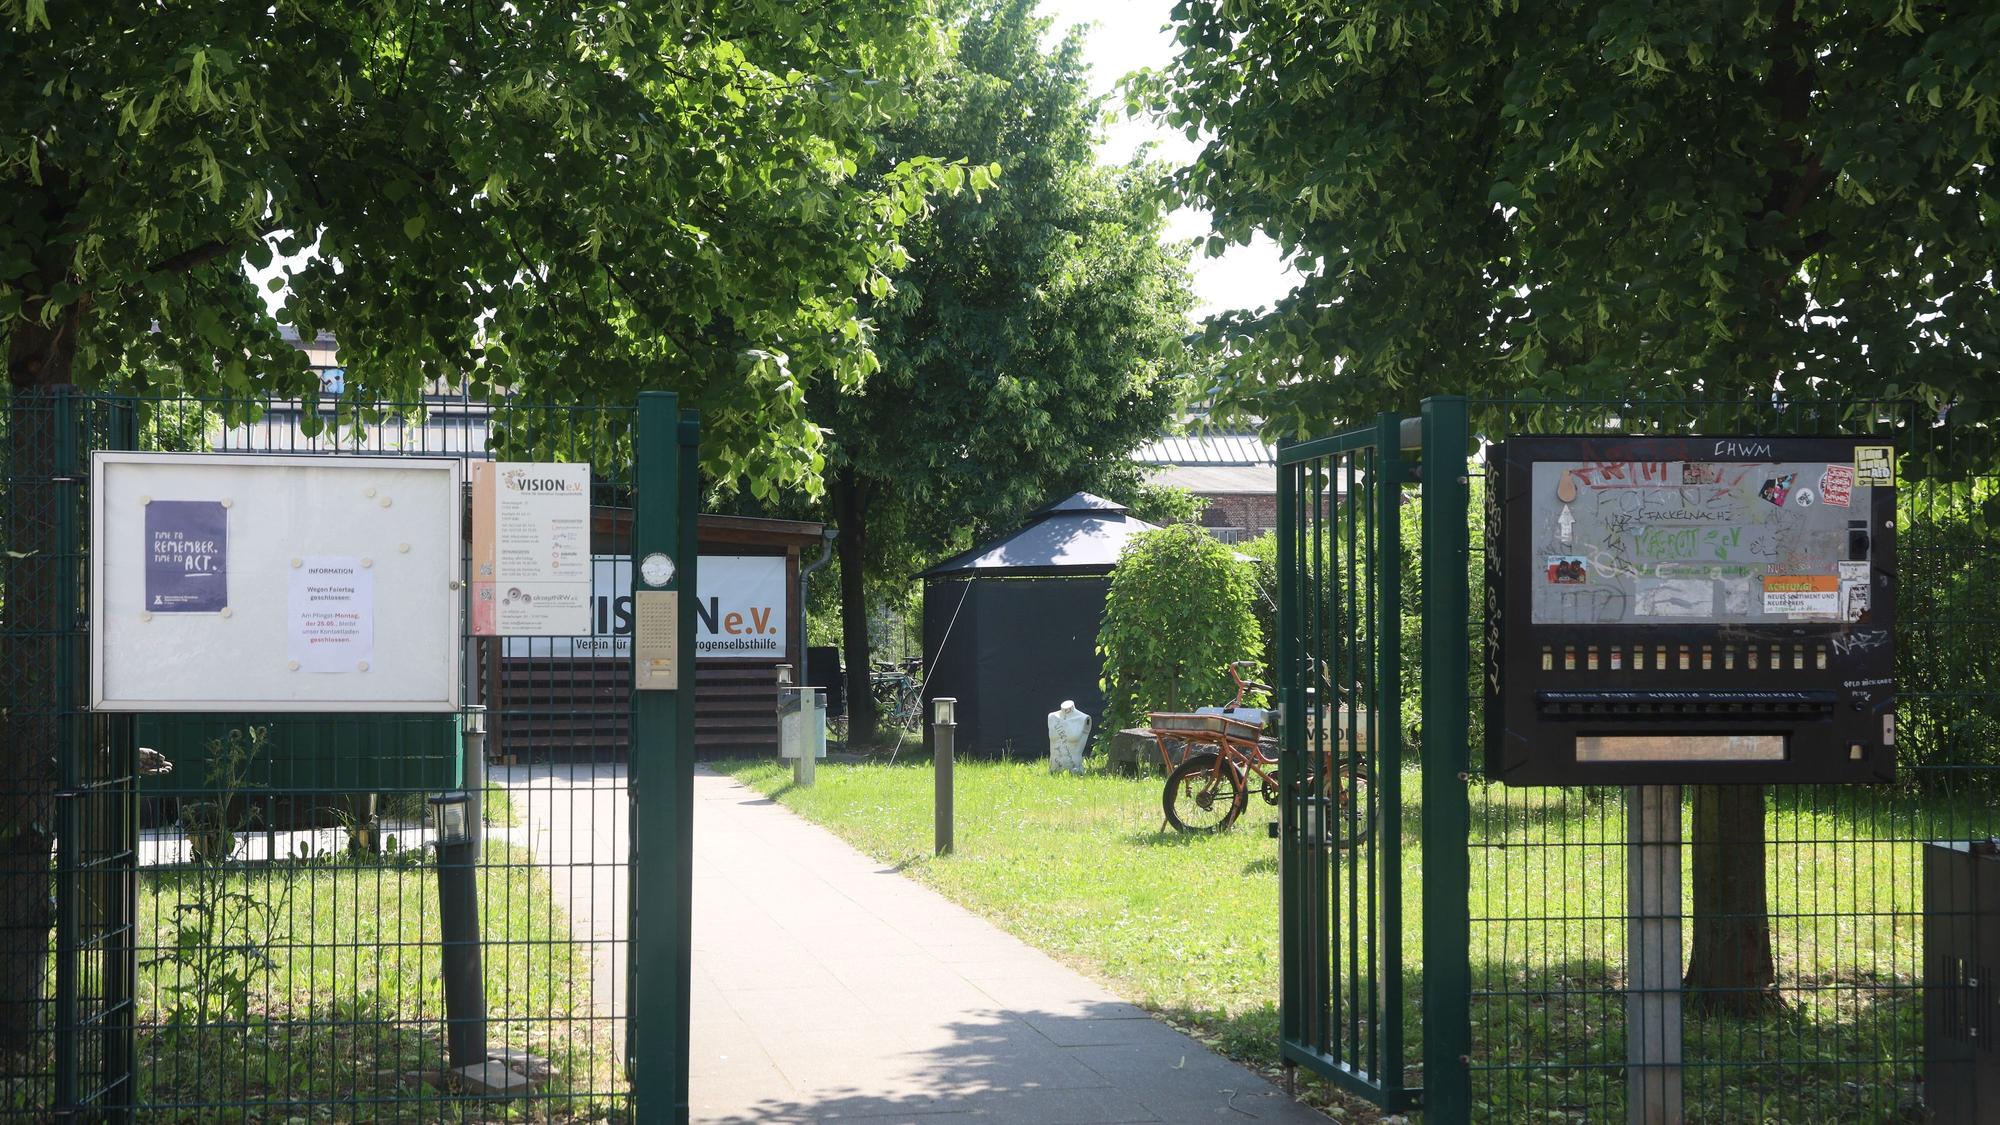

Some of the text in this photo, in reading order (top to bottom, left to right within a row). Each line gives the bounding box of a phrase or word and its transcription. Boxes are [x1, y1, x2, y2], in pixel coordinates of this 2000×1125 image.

[517, 479, 583, 491] VISION e.V.
[155, 532, 183, 540] TIME TO
[154, 541, 218, 553] REMEMBER.
[185, 555, 217, 571] ACT.
[1768, 583, 1812, 591] ACHTUNG!
[724, 608, 776, 634] e.V.
[576, 639, 608, 649] Verein
[695, 639, 776, 652] rogenselbsthilfe
